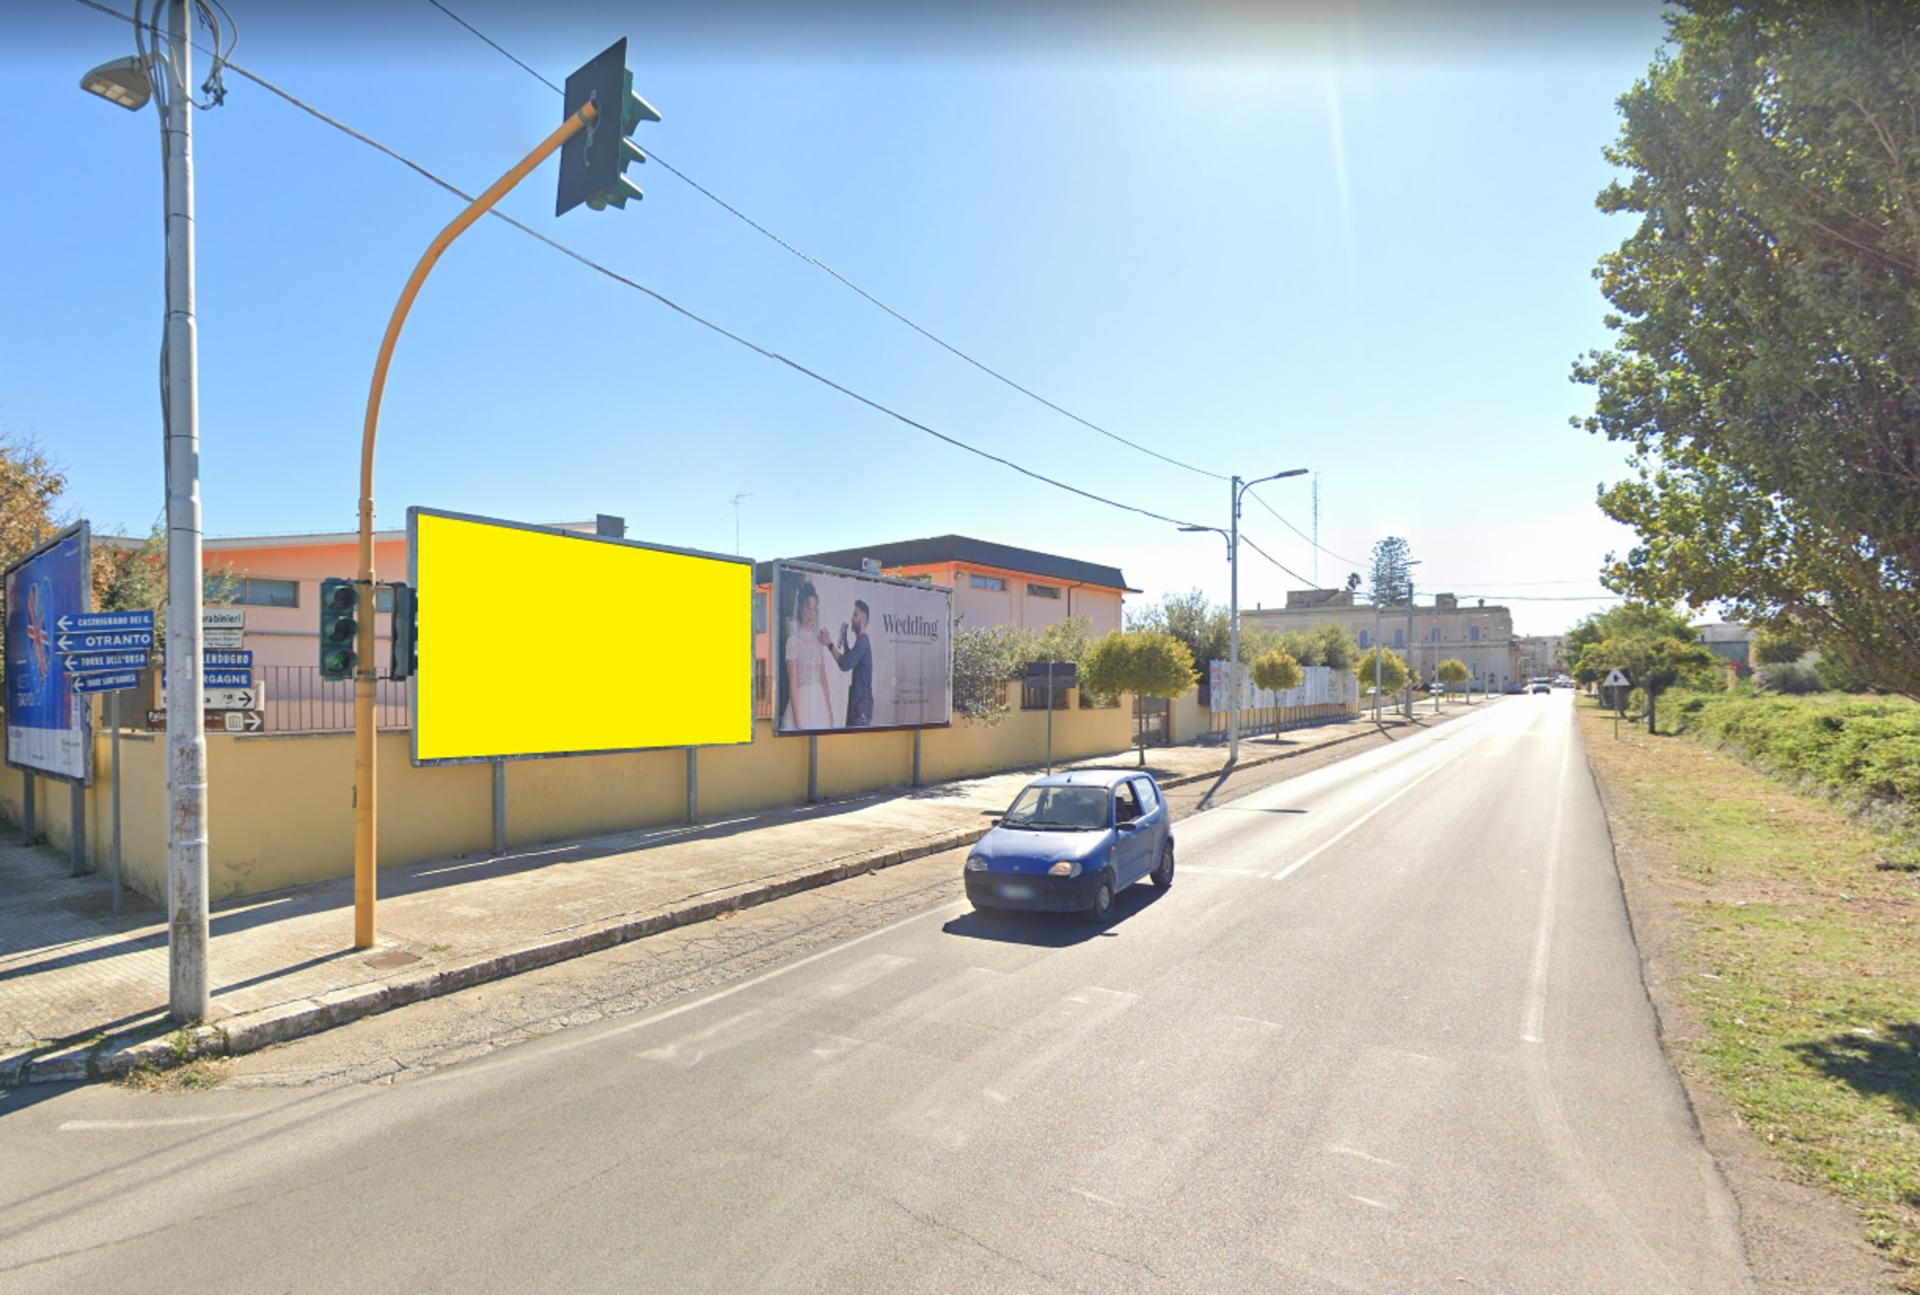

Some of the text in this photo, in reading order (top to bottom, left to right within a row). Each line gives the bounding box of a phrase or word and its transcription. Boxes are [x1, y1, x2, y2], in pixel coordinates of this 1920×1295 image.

[882, 614, 939, 642] Wedding
[85, 633, 151, 647] OTRANTO
[81, 656, 104, 667] TORRE
[203, 674, 248, 685] RGAGNE
